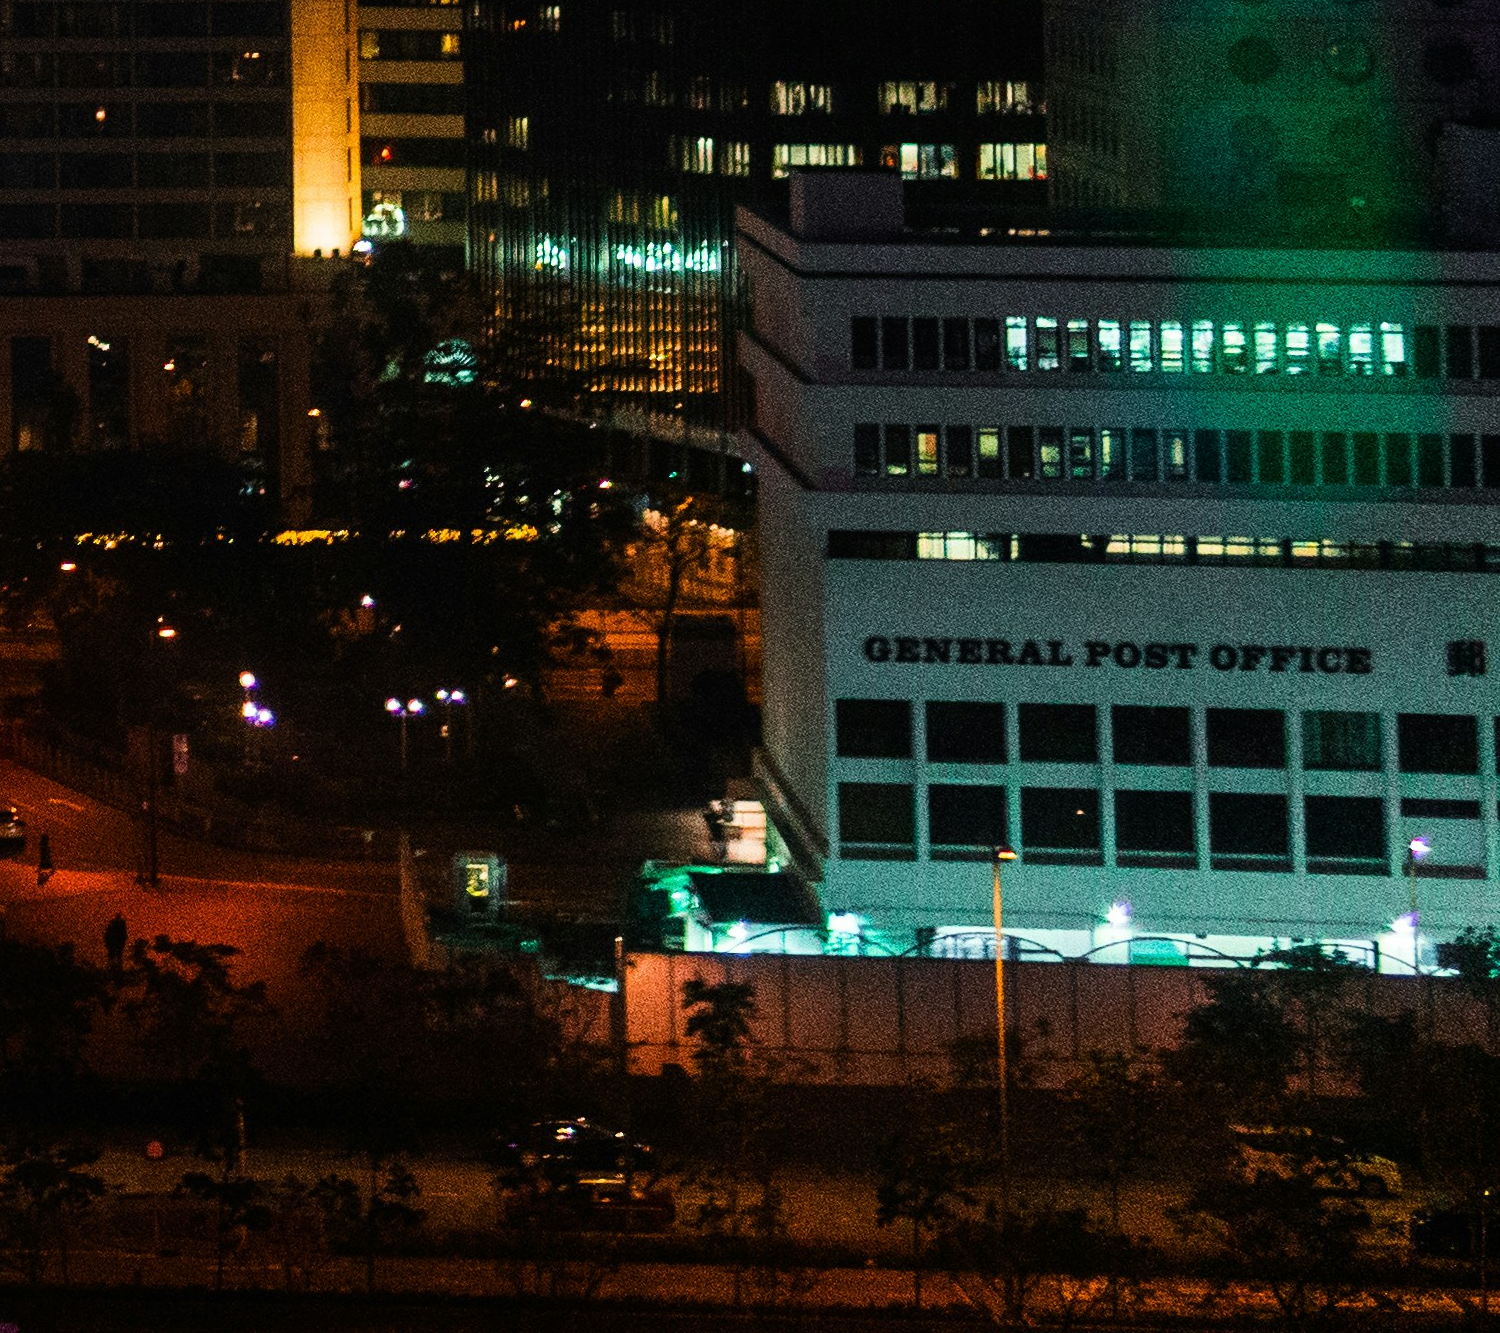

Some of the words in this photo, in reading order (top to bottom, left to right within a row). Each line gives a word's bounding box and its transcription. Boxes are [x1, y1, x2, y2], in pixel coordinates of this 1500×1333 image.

[864, 635, 1067, 667] GENERAL
[1085, 641, 1198, 670] POST
[1210, 645, 1373, 675] OFFICE
